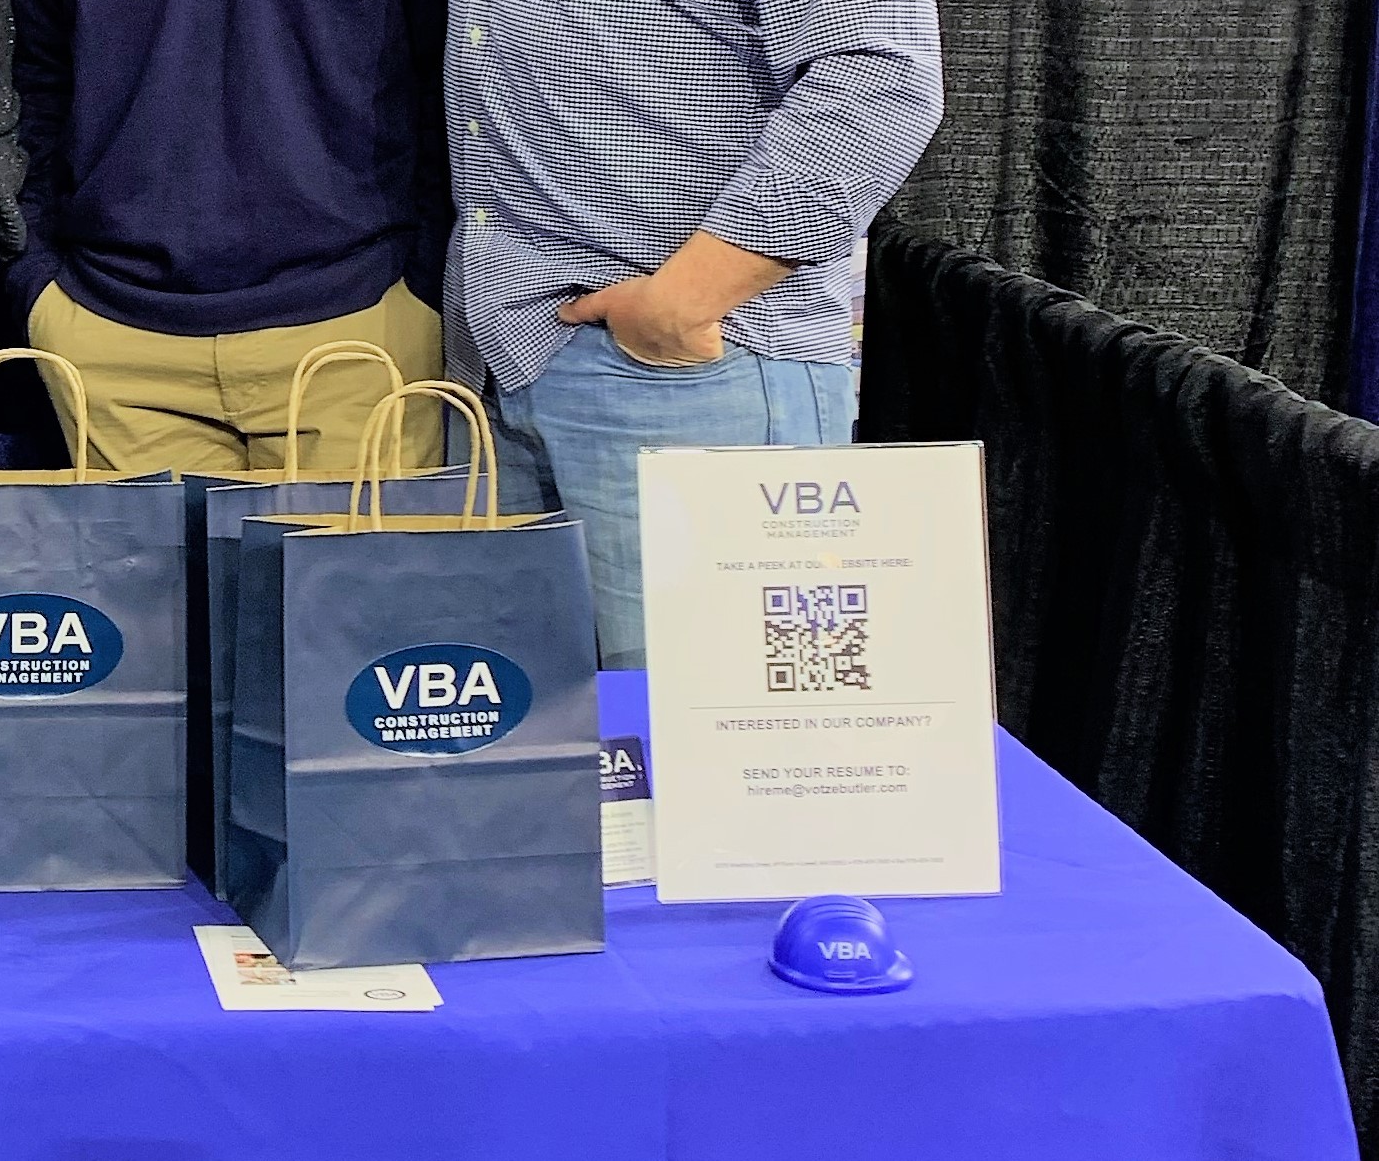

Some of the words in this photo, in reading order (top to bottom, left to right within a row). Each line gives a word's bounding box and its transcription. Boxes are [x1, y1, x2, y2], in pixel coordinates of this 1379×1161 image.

[758, 481, 861, 515] VBA
[761, 518, 861, 529] CONSTRUCTION
[766, 529, 856, 539] MANAGEMENT
[716, 561, 744, 571] TAKE
[748, 562, 755, 570] A
[758, 561, 785, 570] PEEK
[788, 560, 802, 569] AT
[804, 560, 825, 569] OU
[373, 661, 502, 710] VBA
[374, 710, 500, 730] CONSTRUCTION
[716, 718, 801, 731] INTERESTED
[804, 718, 818, 730] IN
[822, 717, 852, 729] OUR
[855, 715, 932, 728] COMPANY?
[381, 723, 494, 743] MANAGEMENT
[743, 768, 780, 779] SEND
[783, 767, 823, 779] YOUR
[827, 766, 883, 778] RESUME
[888, 765, 910, 776] TO:
[747, 782, 908, 798] hireme@votzebutler.com
[817, 941, 872, 960] VBA
